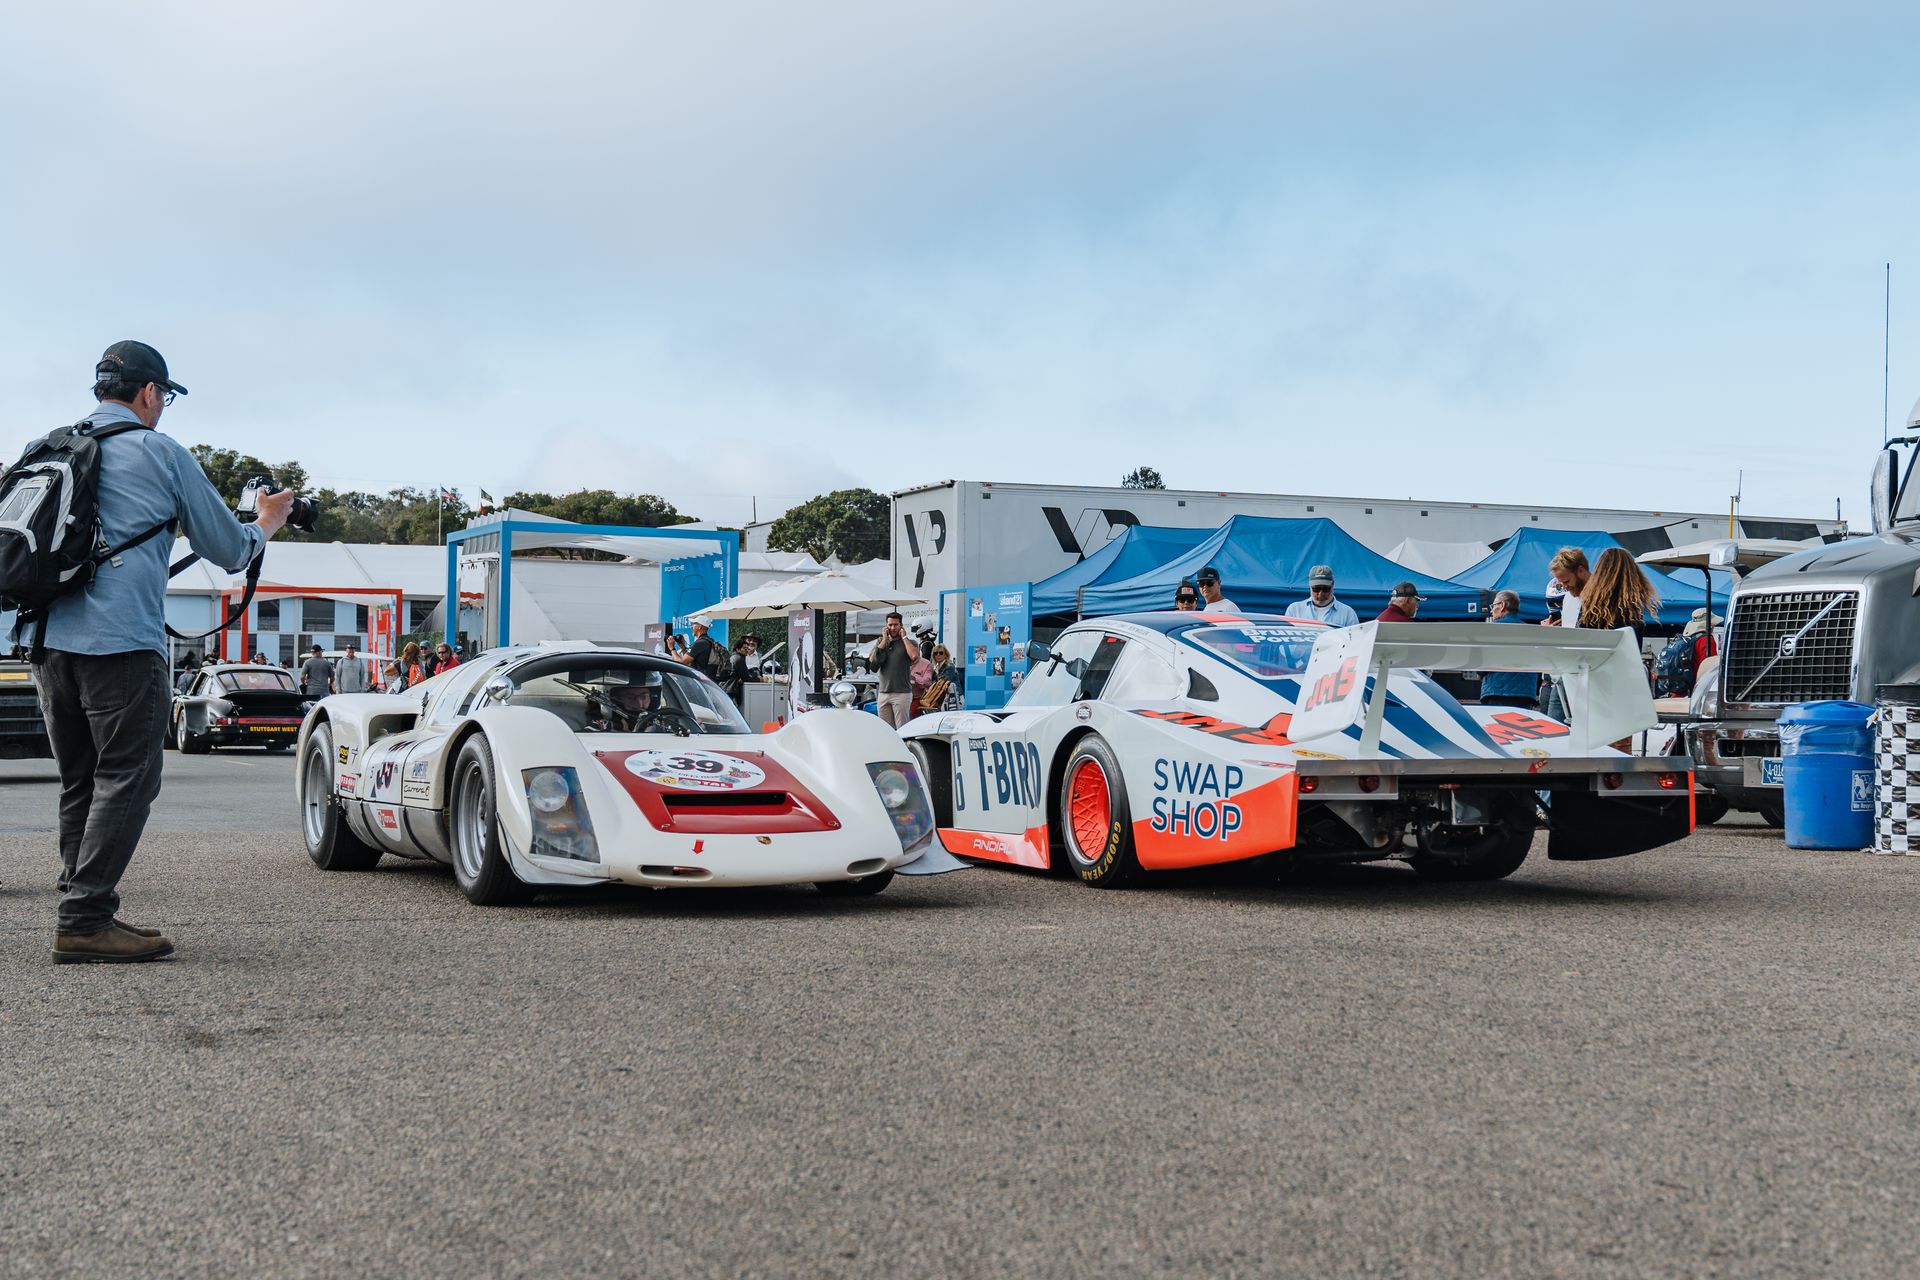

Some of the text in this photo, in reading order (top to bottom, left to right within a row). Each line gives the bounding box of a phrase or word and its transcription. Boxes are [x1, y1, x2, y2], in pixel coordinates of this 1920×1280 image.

[664, 564, 685, 572] PORSCHE
[1240, 628, 1320, 637] Brumo
[1249, 635, 1316, 643] Porsc
[1304, 656, 1359, 712] JMS
[969, 739, 987, 750] HENN'S
[667, 756, 724, 774] 39
[975, 740, 1042, 812] T-BIRD
[1153, 758, 1243, 798] SWAP
[1151, 797, 1242, 842] SHOP
[973, 838, 1013, 855] ANDIAL
[1082, 821, 1121, 880] GOODYEAR
